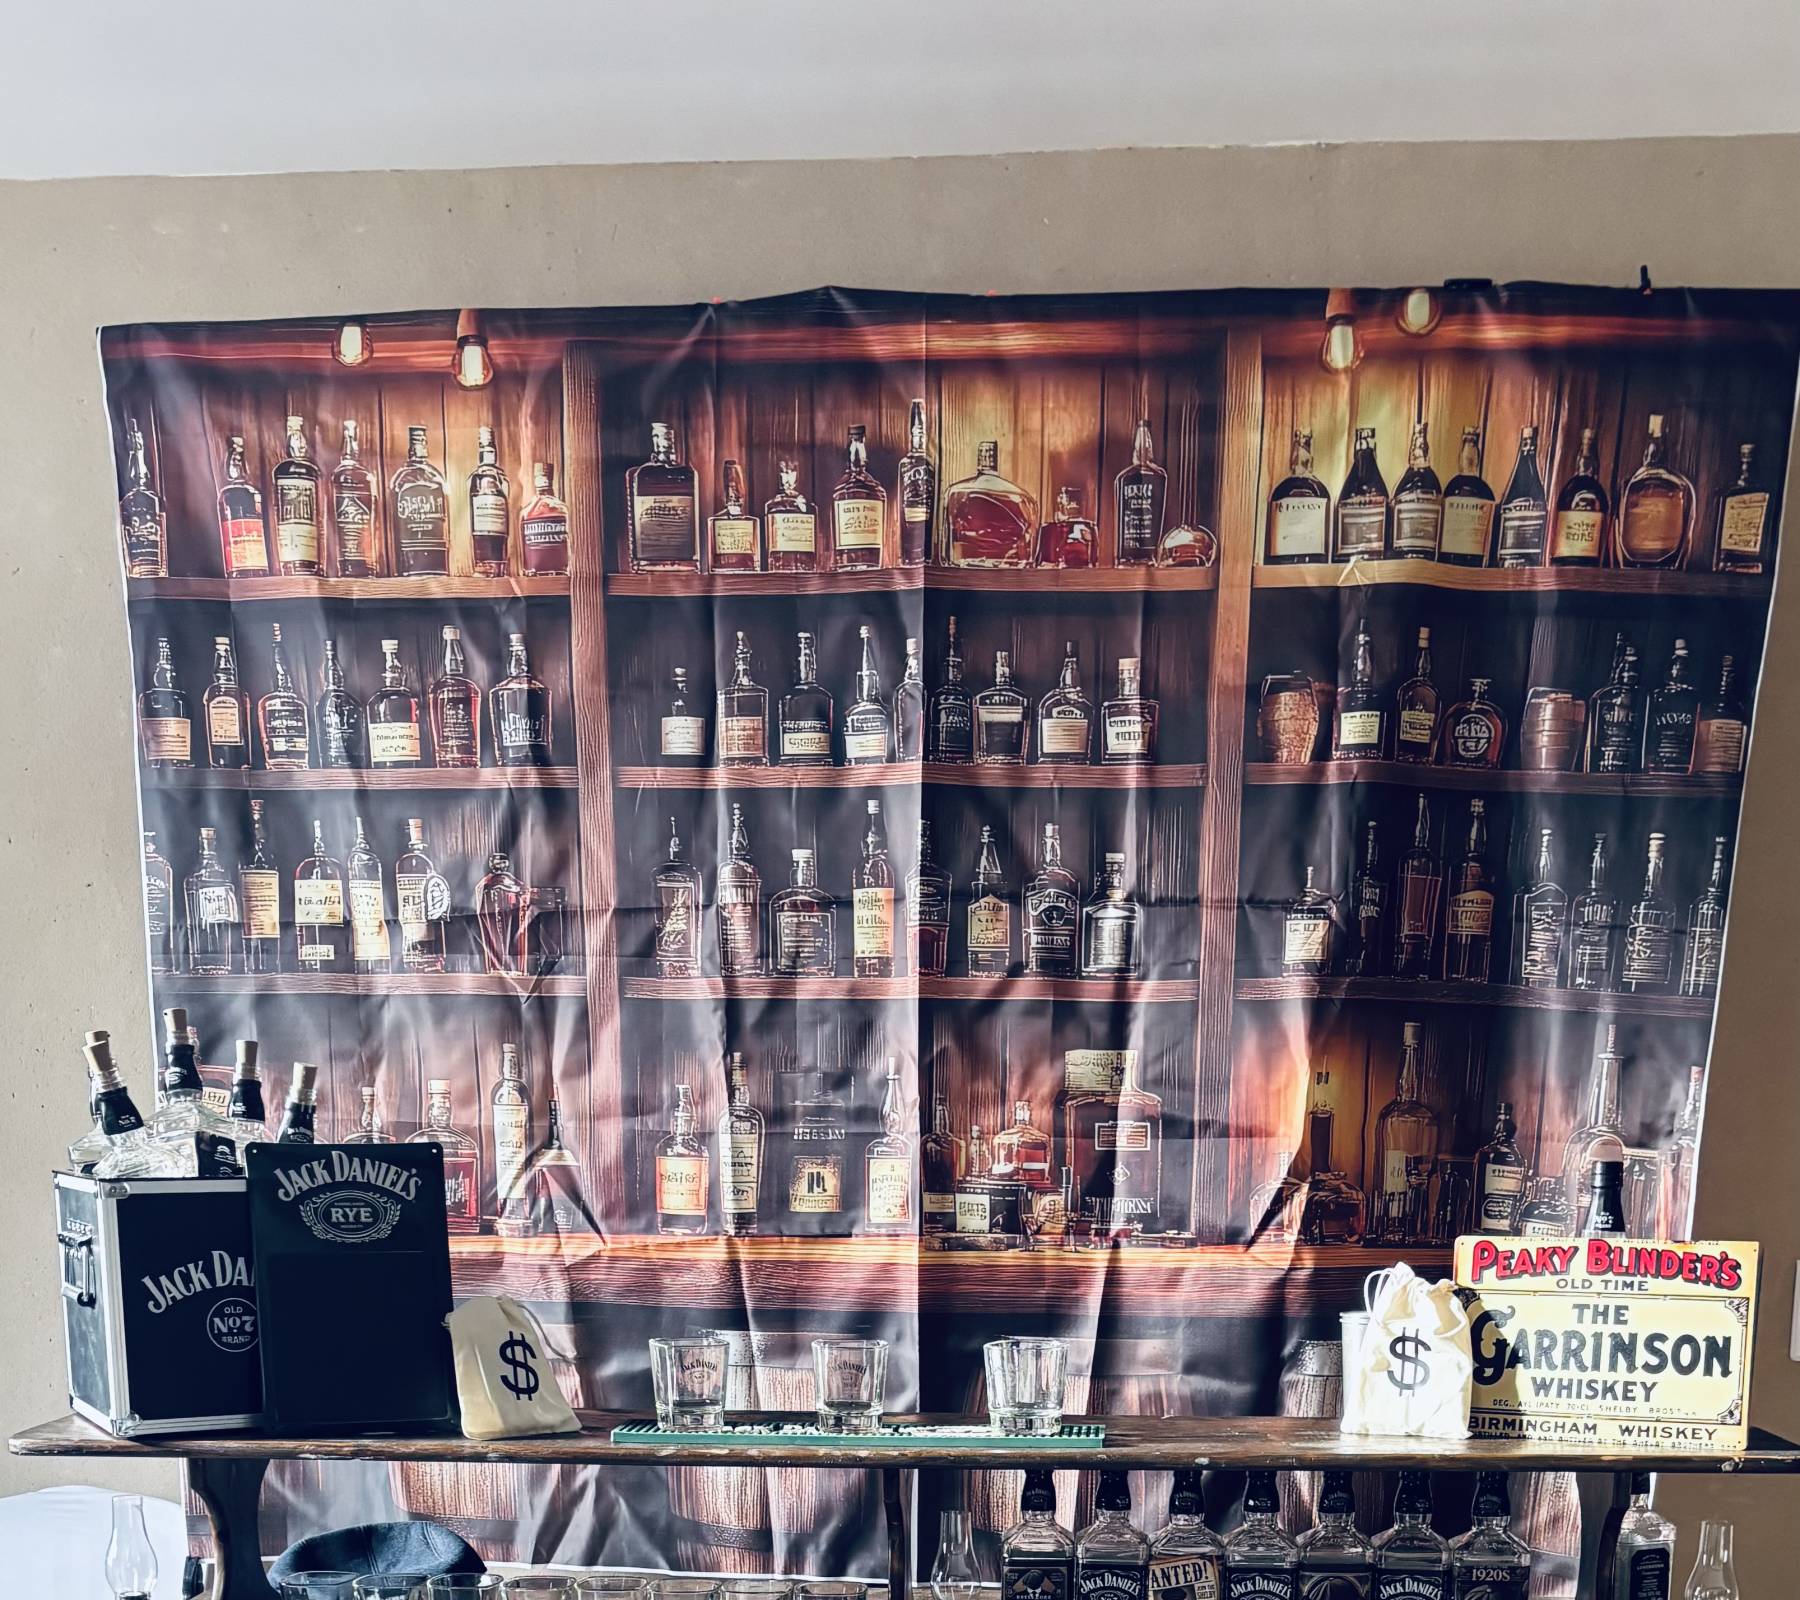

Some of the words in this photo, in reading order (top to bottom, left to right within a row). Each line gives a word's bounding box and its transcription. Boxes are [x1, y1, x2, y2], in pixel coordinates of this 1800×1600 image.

[273, 1158, 333, 1201] JACK
[331, 1150, 422, 1202] DANIEL'S
[330, 1207, 373, 1223] RYE
[1471, 1240, 1579, 1284] PEAKY
[1587, 1239, 1742, 1290] BLINDER'S
[141, 1260, 213, 1314] JACK
[1556, 1278, 1593, 1290] OLD
[1601, 1279, 1649, 1292] TIME
[224, 1306, 243, 1314] OLD
[1572, 1303, 1629, 1326] THE
[1470, 1305, 1733, 1386] GARRINSON
[1531, 1376, 1659, 1403] WHISKEY
[1468, 1415, 1598, 1436] BIRMINGHAM
[1618, 1424, 1718, 1441] WHISKEY
[1080, 1574, 1104, 1594] JACK
[1471, 1568, 1511, 1581] 1920S
[1230, 1580, 1255, 1598] JACK
[1380, 1581, 1405, 1600] JACK
